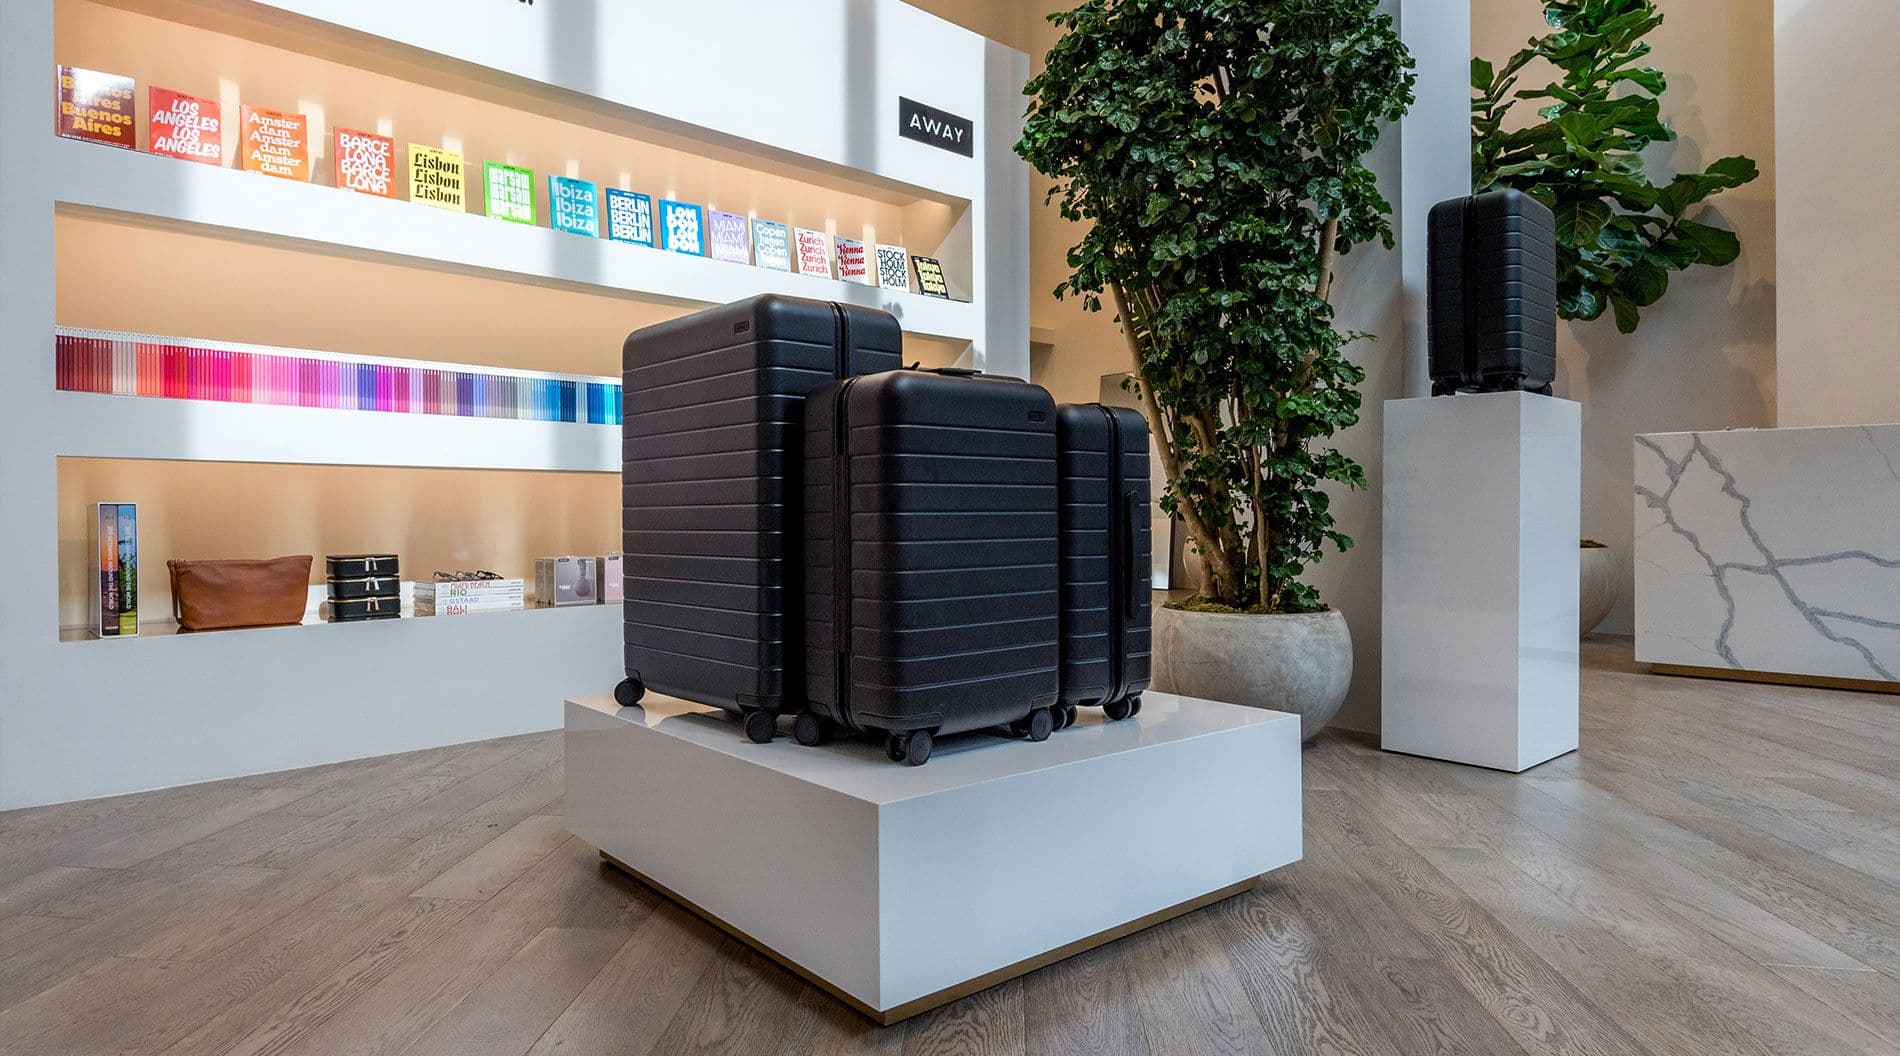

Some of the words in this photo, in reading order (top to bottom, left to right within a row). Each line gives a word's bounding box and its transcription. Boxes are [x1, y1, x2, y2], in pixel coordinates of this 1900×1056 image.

[62, 101, 132, 126] Buenos
[171, 99, 200, 116] LOS
[72, 117, 122, 137] Aires
[152, 109, 219, 133] ANGELES
[249, 112, 300, 129] Amster
[909, 113, 964, 143] AWAY
[172, 126, 201, 143] LOS
[259, 123, 291, 138] dam
[154, 136, 221, 158] ANGELES
[250, 131, 301, 148] Amster
[340, 133, 391, 157] BARCE
[250, 149, 302, 166] Amster
[260, 142, 292, 156] dam
[345, 148, 387, 168] LONA
[414, 152, 459, 175] Lisbon
[261, 161, 293, 175] dam
[341, 159, 392, 183] BARCE
[345, 173, 388, 195] LONA
[414, 168, 460, 190] Lisbon
[415, 184, 460, 205] Lisbon
[554, 182, 593, 202] Ibiza
[556, 197, 594, 217] Ibiza
[557, 211, 595, 232] Ibiza
[798, 233, 825, 247] Zurich
[799, 243, 826, 256] Zurich
[837, 243, 864, 256] Vienna
[877, 249, 905, 262] STOCK
[800, 253, 827, 266] Zurich
[838, 254, 865, 267] Vienna
[880, 259, 905, 270] HOLM
[801, 262, 829, 275] Zurich
[839, 265, 866, 278] Vienna
[879, 267, 907, 280] STOCK
[882, 276, 907, 288] HOLM
